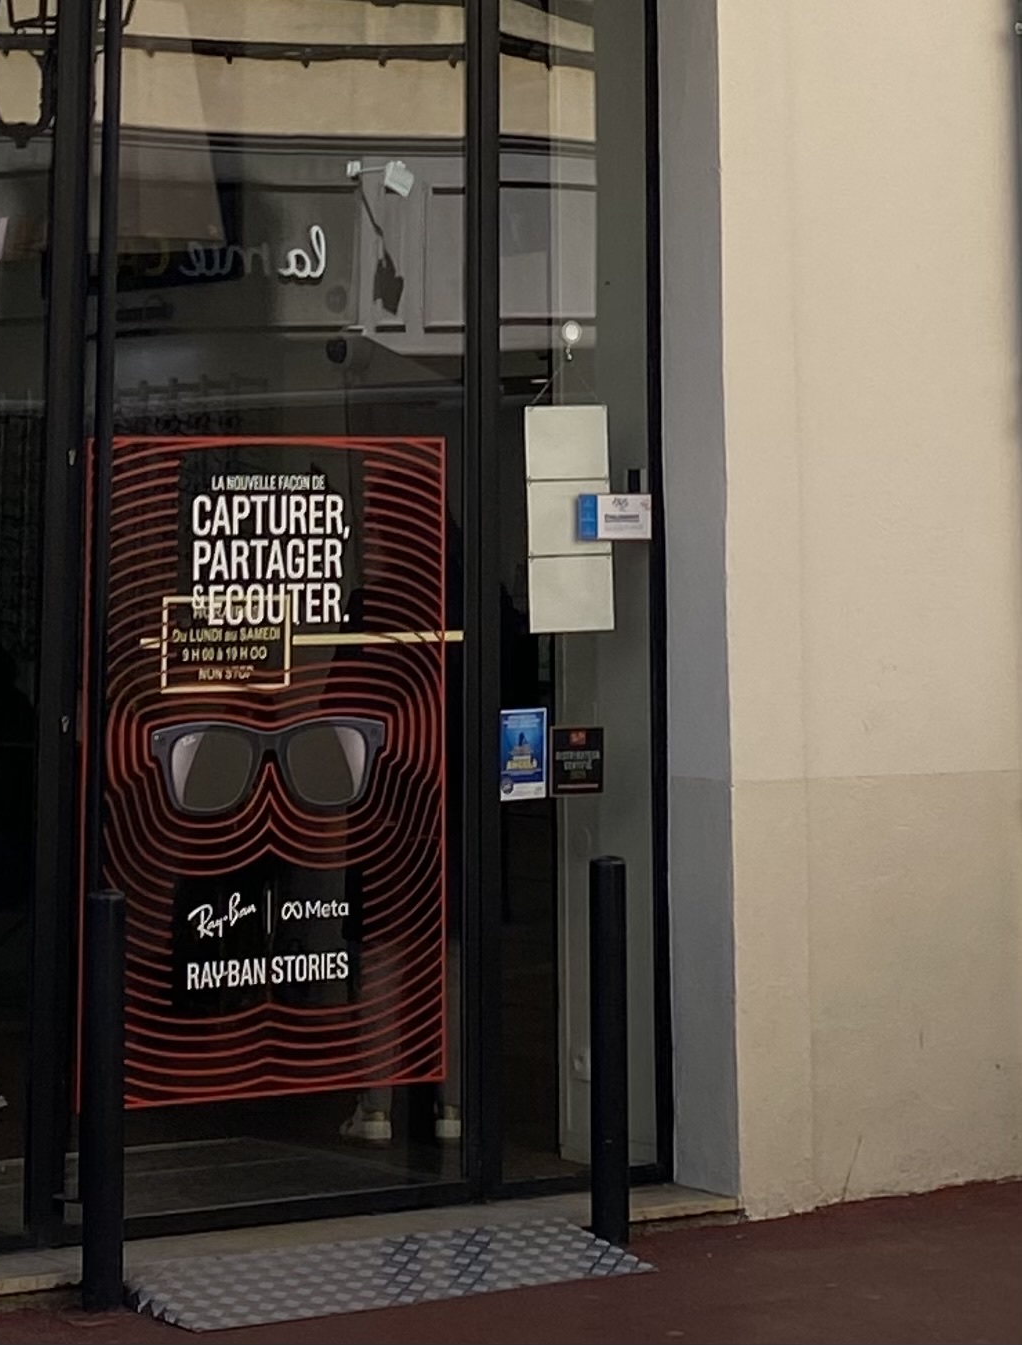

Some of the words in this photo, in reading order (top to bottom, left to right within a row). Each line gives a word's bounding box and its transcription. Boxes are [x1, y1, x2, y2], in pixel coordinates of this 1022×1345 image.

[211, 475, 225, 490] LA
[226, 475, 276, 491] NOUVELLE
[312, 474, 325, 490] DE
[191, 493, 350, 540] CAPTURER,
[192, 538, 343, 581] PARTAGER
[189, 627, 222, 643] LUNDI
[239, 626, 281, 642] SAMEDI
[198, 667, 223, 681] NON
[304, 899, 350, 920] Meta
[187, 957, 266, 990] RAY-BAN
[271, 951, 349, 984] STORIES
